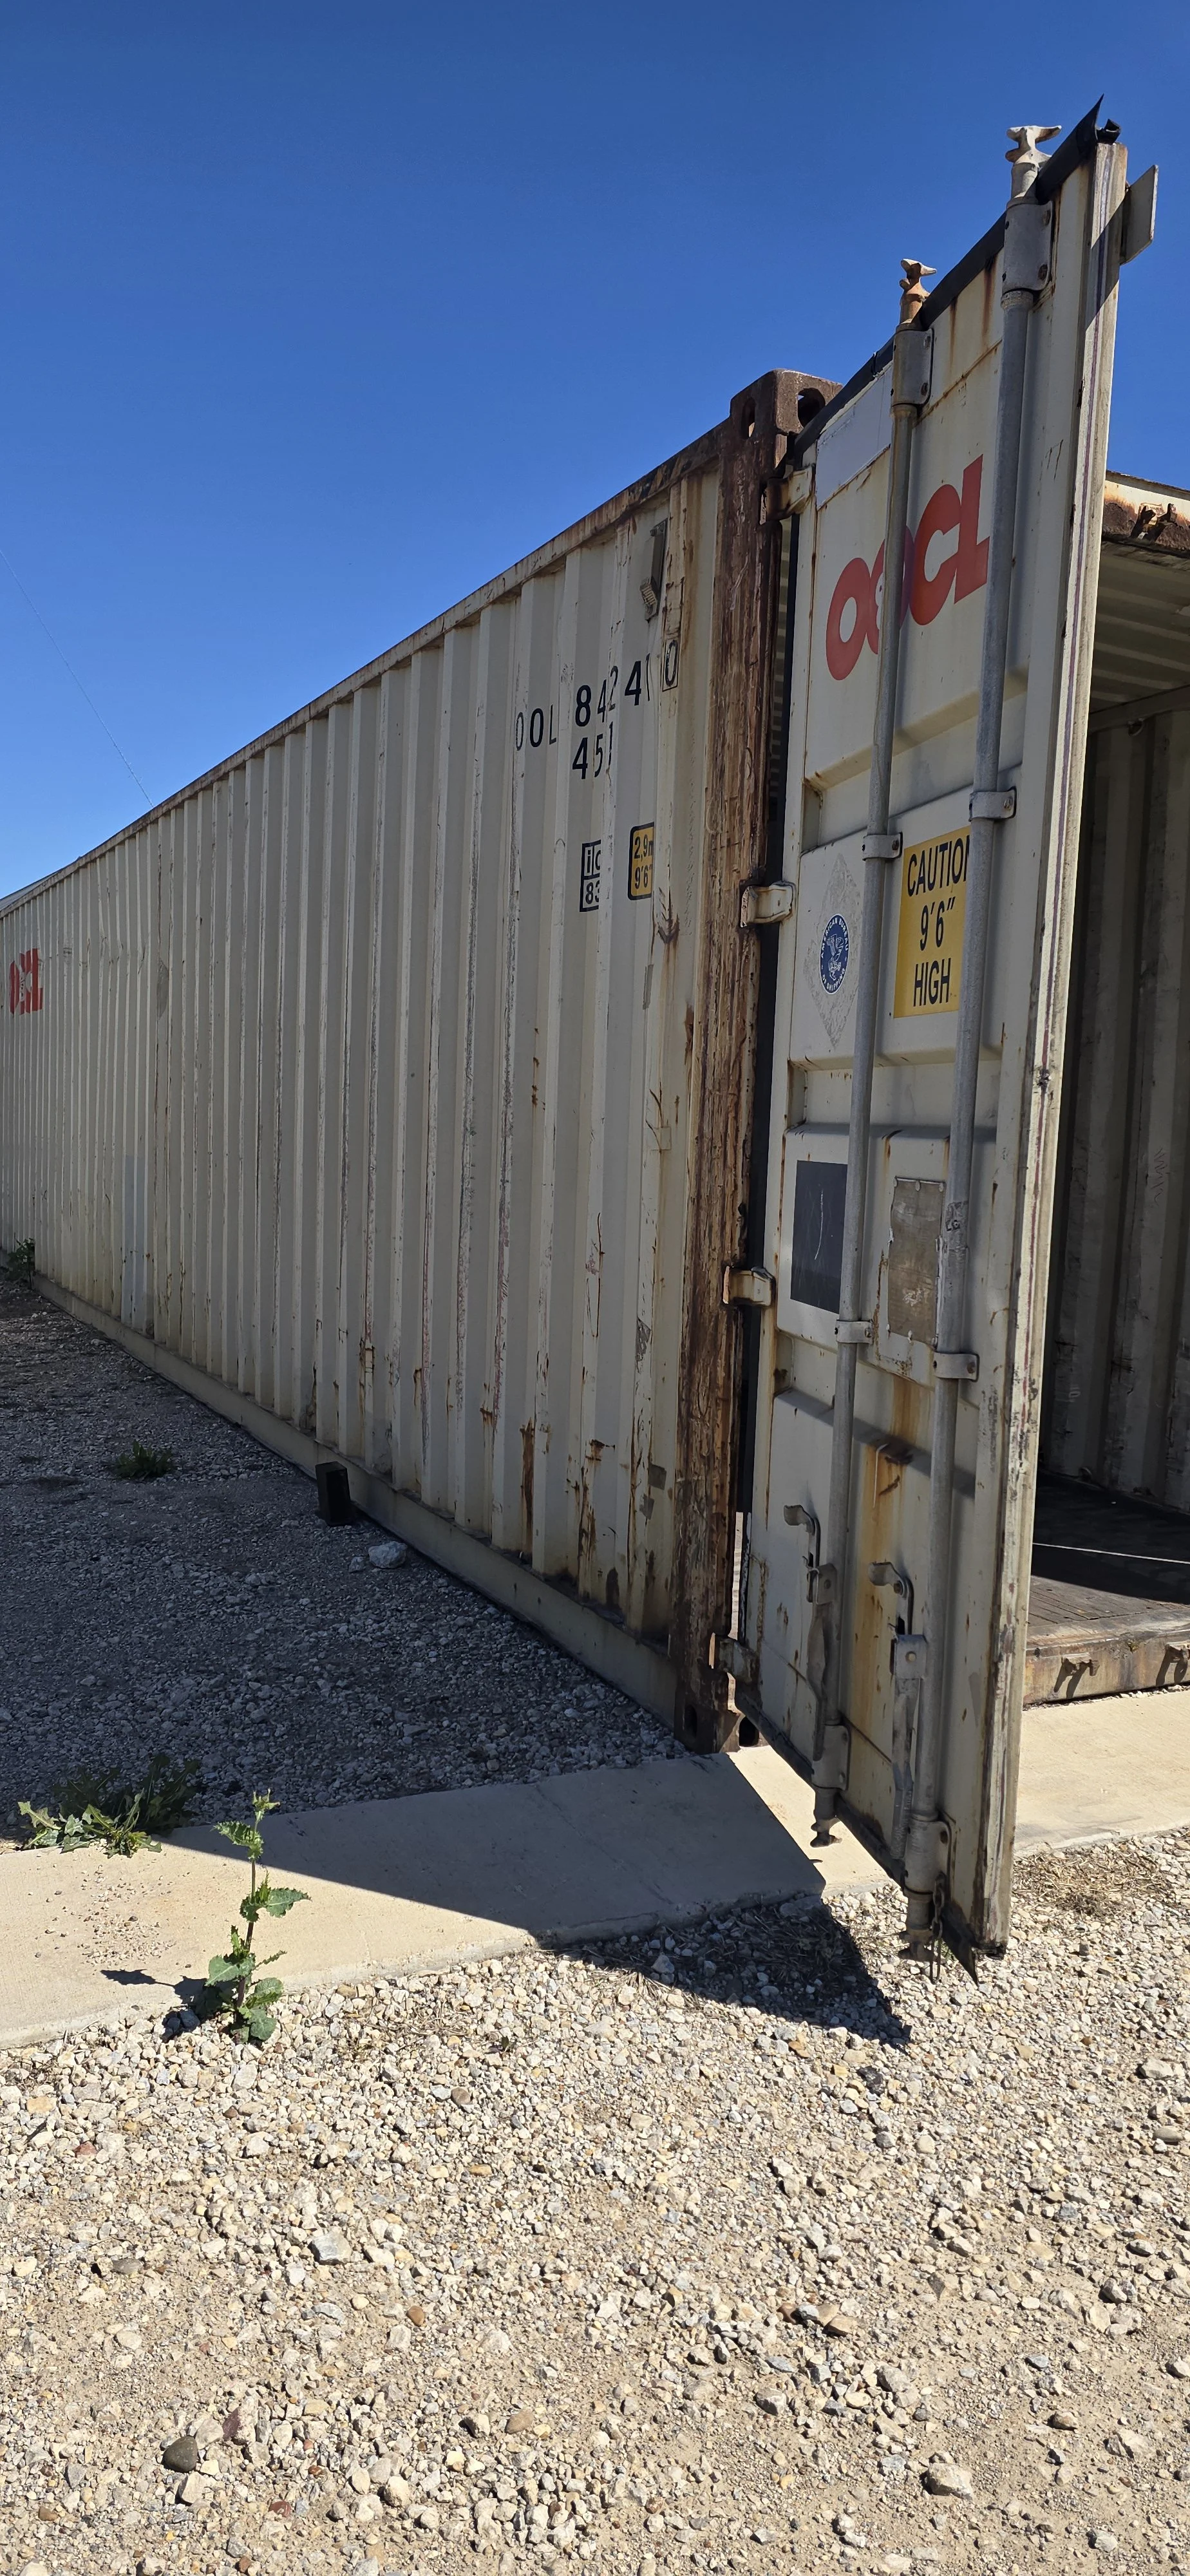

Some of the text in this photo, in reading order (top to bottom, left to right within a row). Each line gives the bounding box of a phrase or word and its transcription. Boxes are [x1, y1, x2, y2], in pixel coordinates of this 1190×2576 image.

[826, 453, 990, 681] OOCL
[820, 917, 849, 959] AMERICAN BUREAU
[826, 967, 845, 992] SHIPPING
[912, 958, 952, 1007] HIGH
